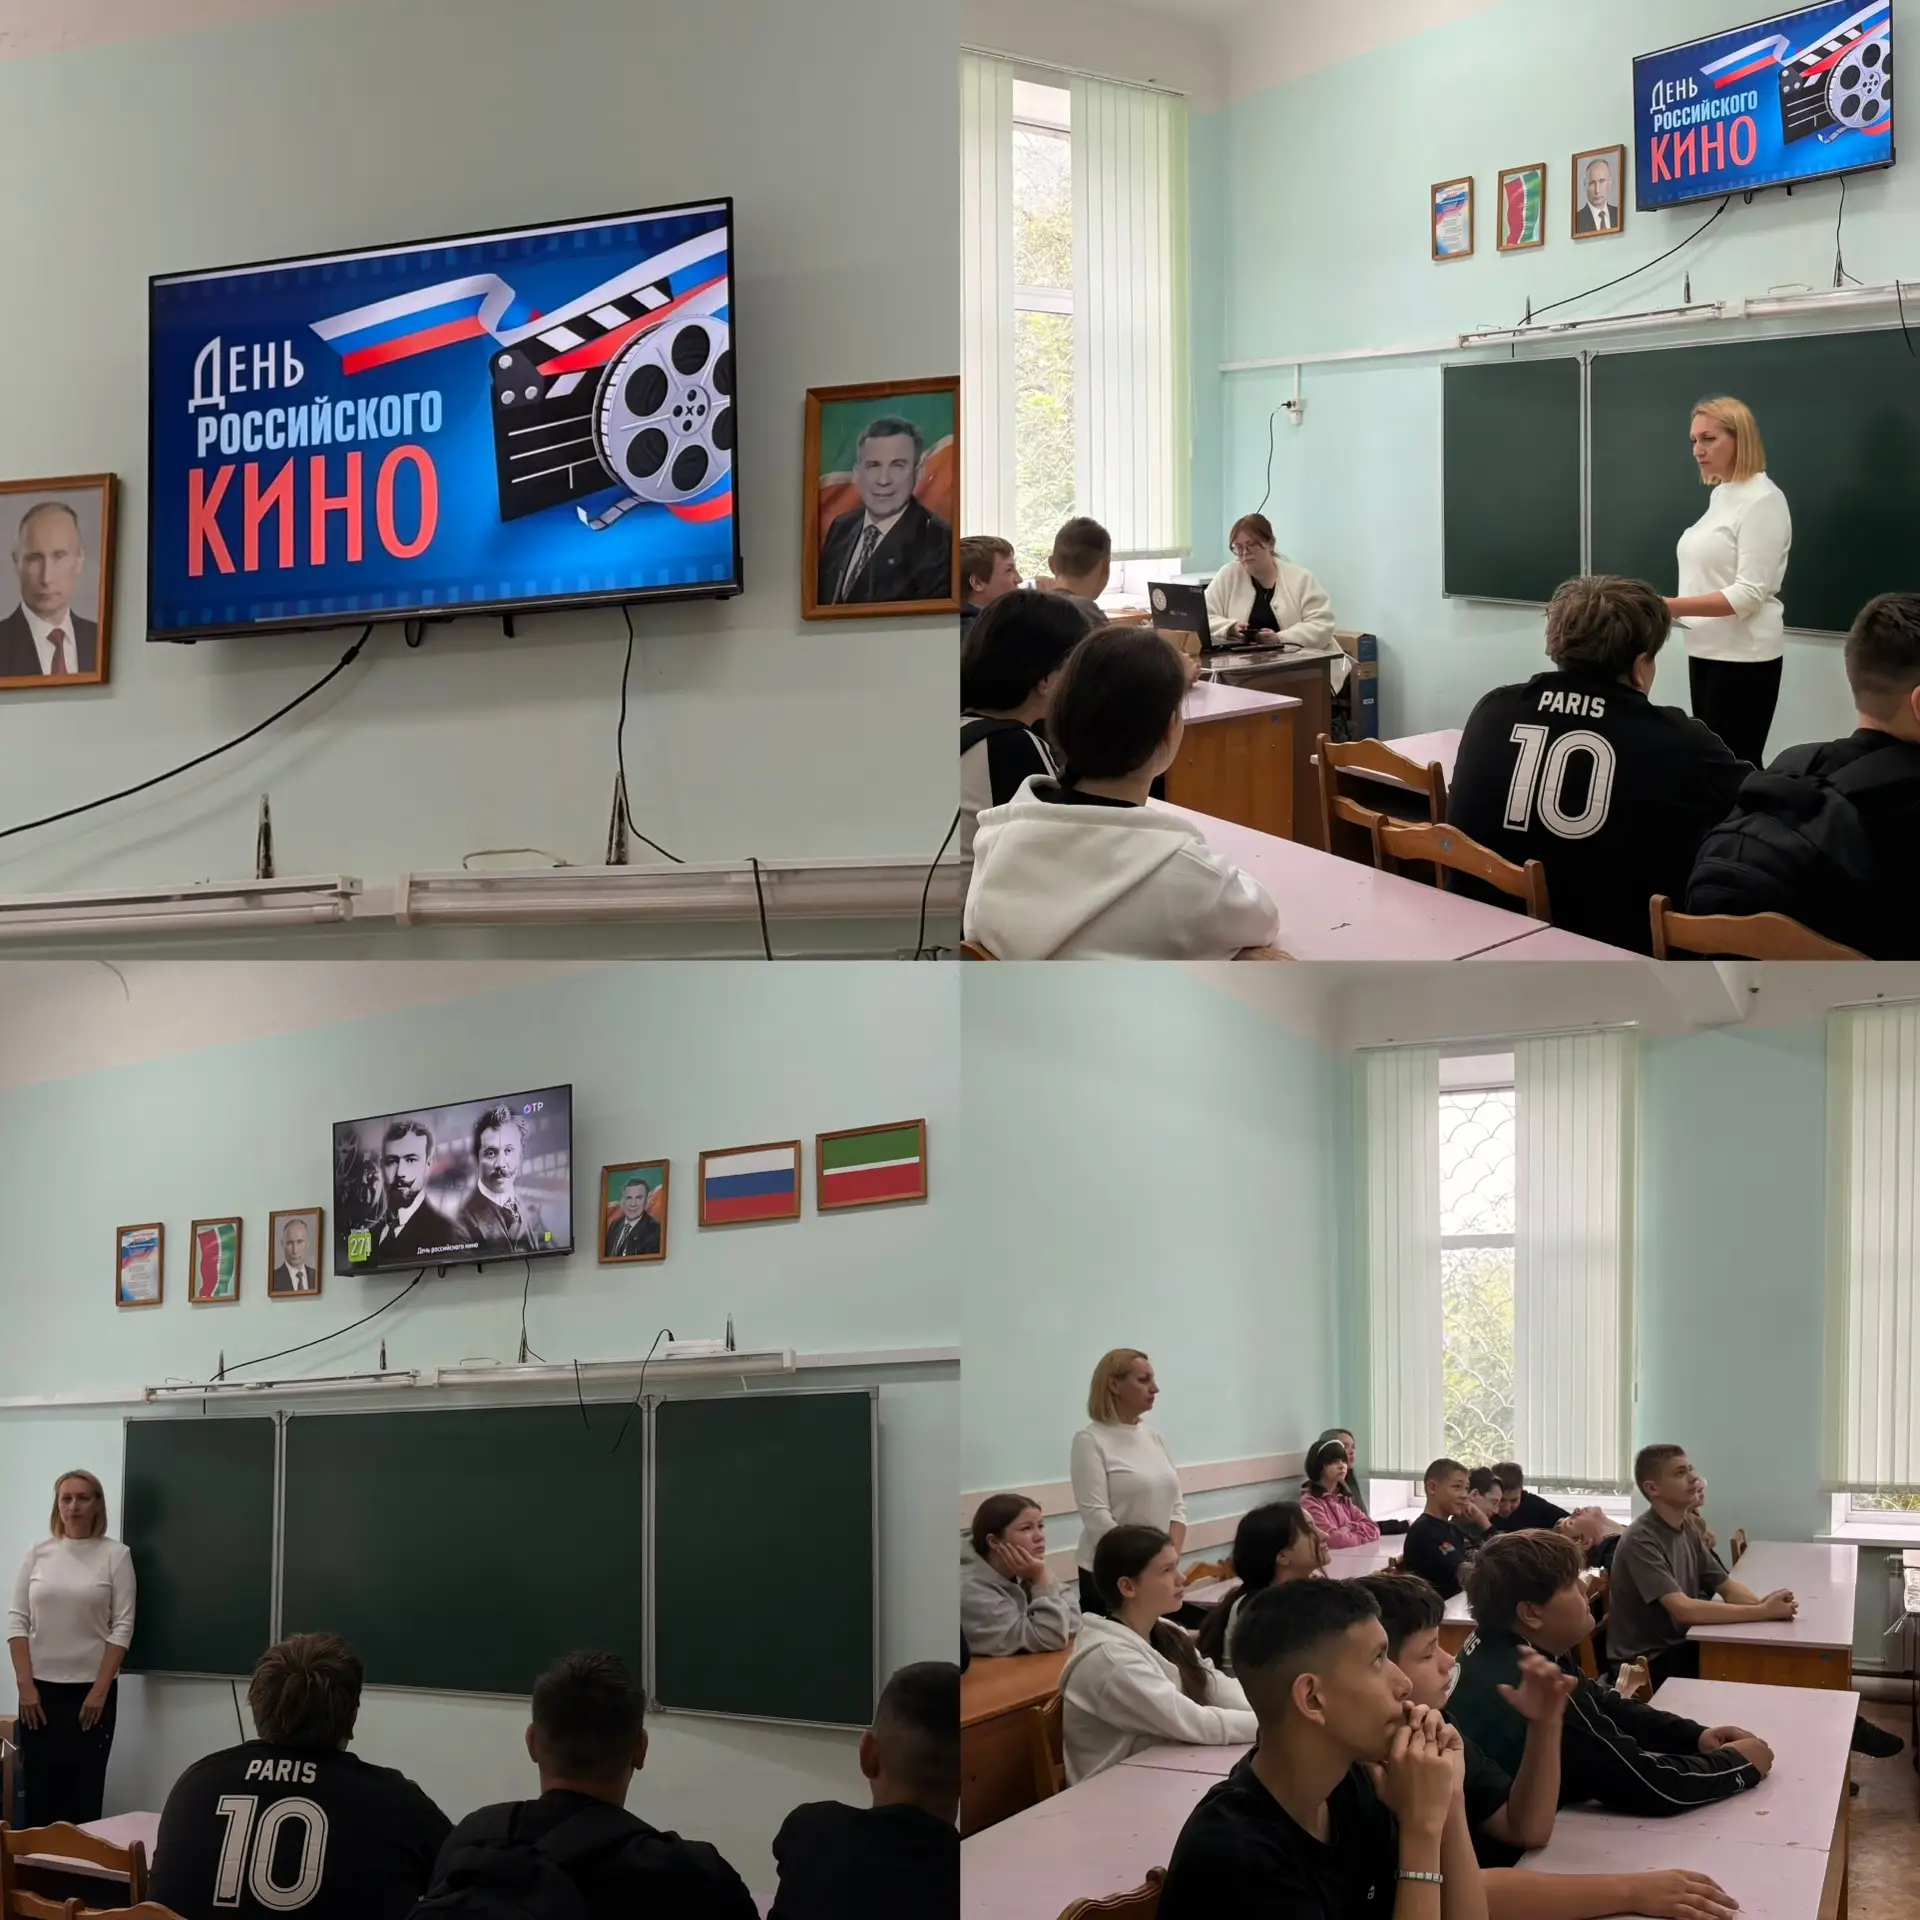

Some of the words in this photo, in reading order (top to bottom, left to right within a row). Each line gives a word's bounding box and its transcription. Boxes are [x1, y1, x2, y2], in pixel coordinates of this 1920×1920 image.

[1654, 90, 1758, 132] РОССИЙСКОГО
[1651, 116, 1757, 183] КИНО
[197, 390, 442, 457] РОССИЙСКОГО
[188, 444, 439, 577] КИНО
[1537, 690, 1606, 718] PARIS
[1503, 723, 1617, 839] 10
[350, 1237, 365, 1256] 27
[244, 1759, 317, 1784] PARIS
[212, 1794, 329, 1911] 10
